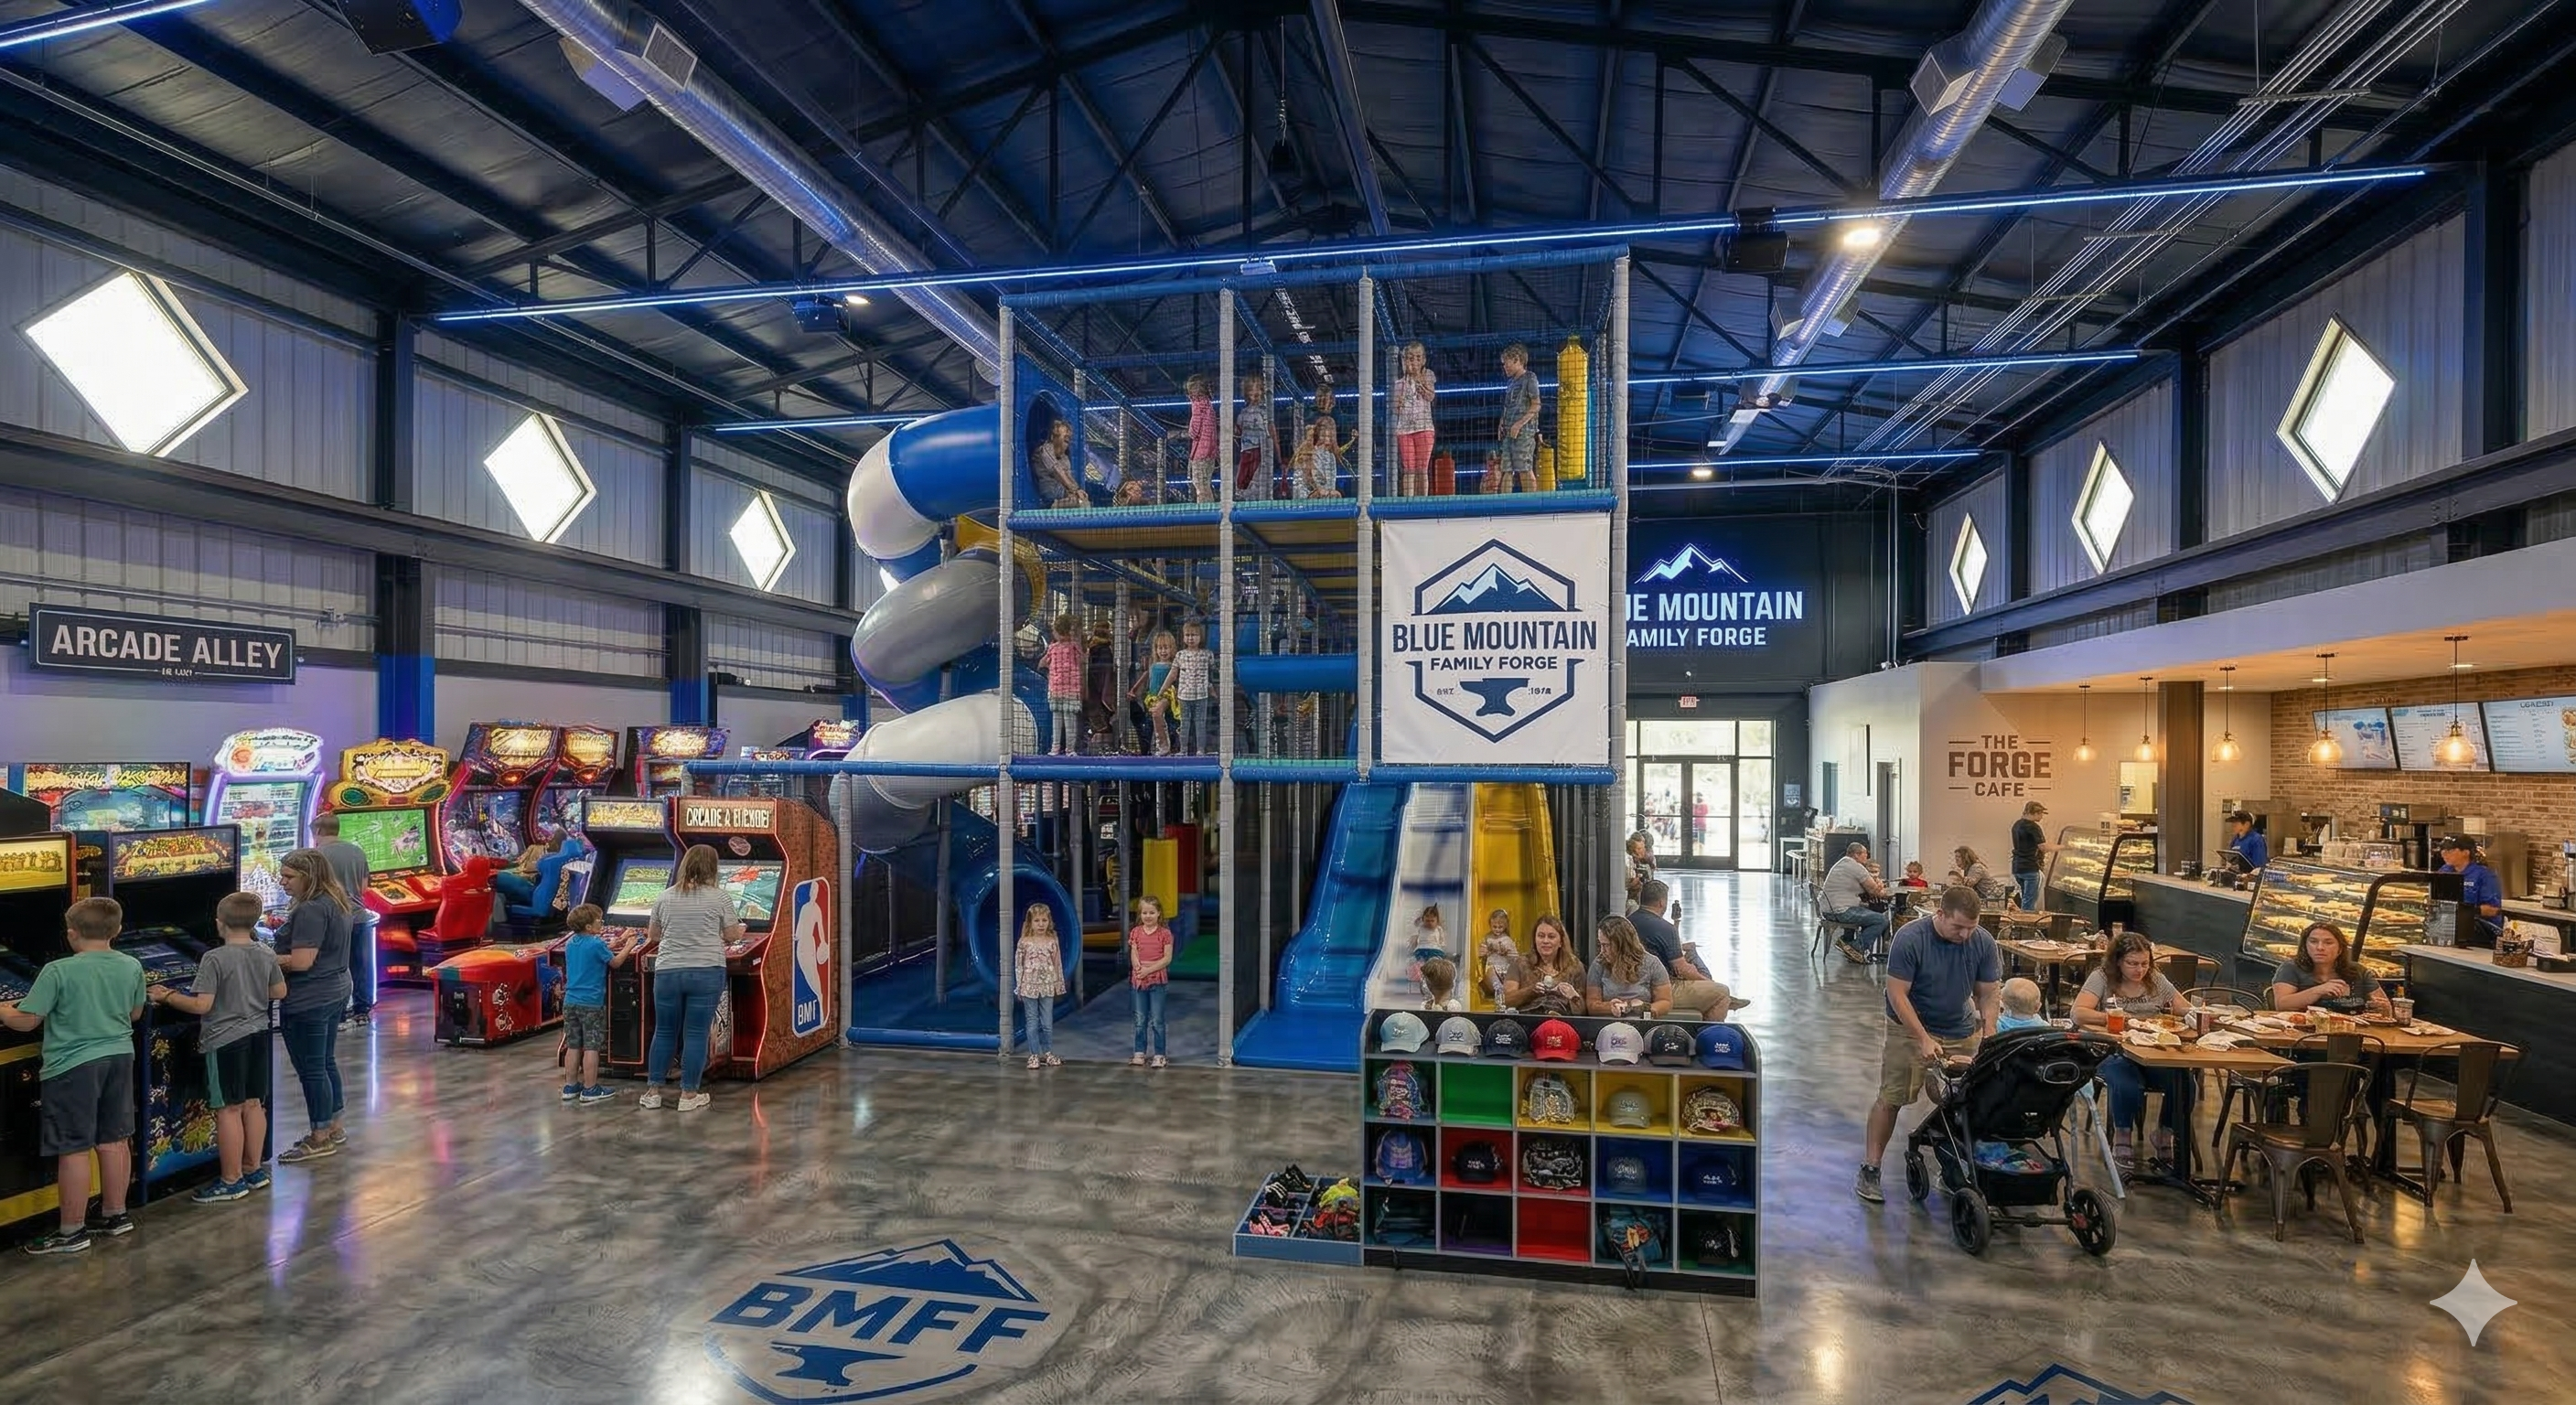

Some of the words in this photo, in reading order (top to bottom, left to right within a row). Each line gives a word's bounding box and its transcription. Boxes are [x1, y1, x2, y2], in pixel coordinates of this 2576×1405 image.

[1658, 592, 1802, 621] MOUNTAIN
[51, 625, 182, 662] ARCADE
[191, 638, 283, 669] ALLEY
[1392, 623, 1454, 653] BLUE
[1464, 621, 1597, 650] MOUNTAIN
[1626, 628, 1690, 648] AMILY
[1697, 627, 1766, 646] FORGE
[1430, 658, 1494, 670] FAMILY
[1498, 657, 1558, 669] FORGE
[1981, 735, 2019, 749] THE
[1948, 751, 2051, 778] FORGE
[1974, 782, 2024, 797] CAFE
[709, 1282, 1050, 1352] BMFF
